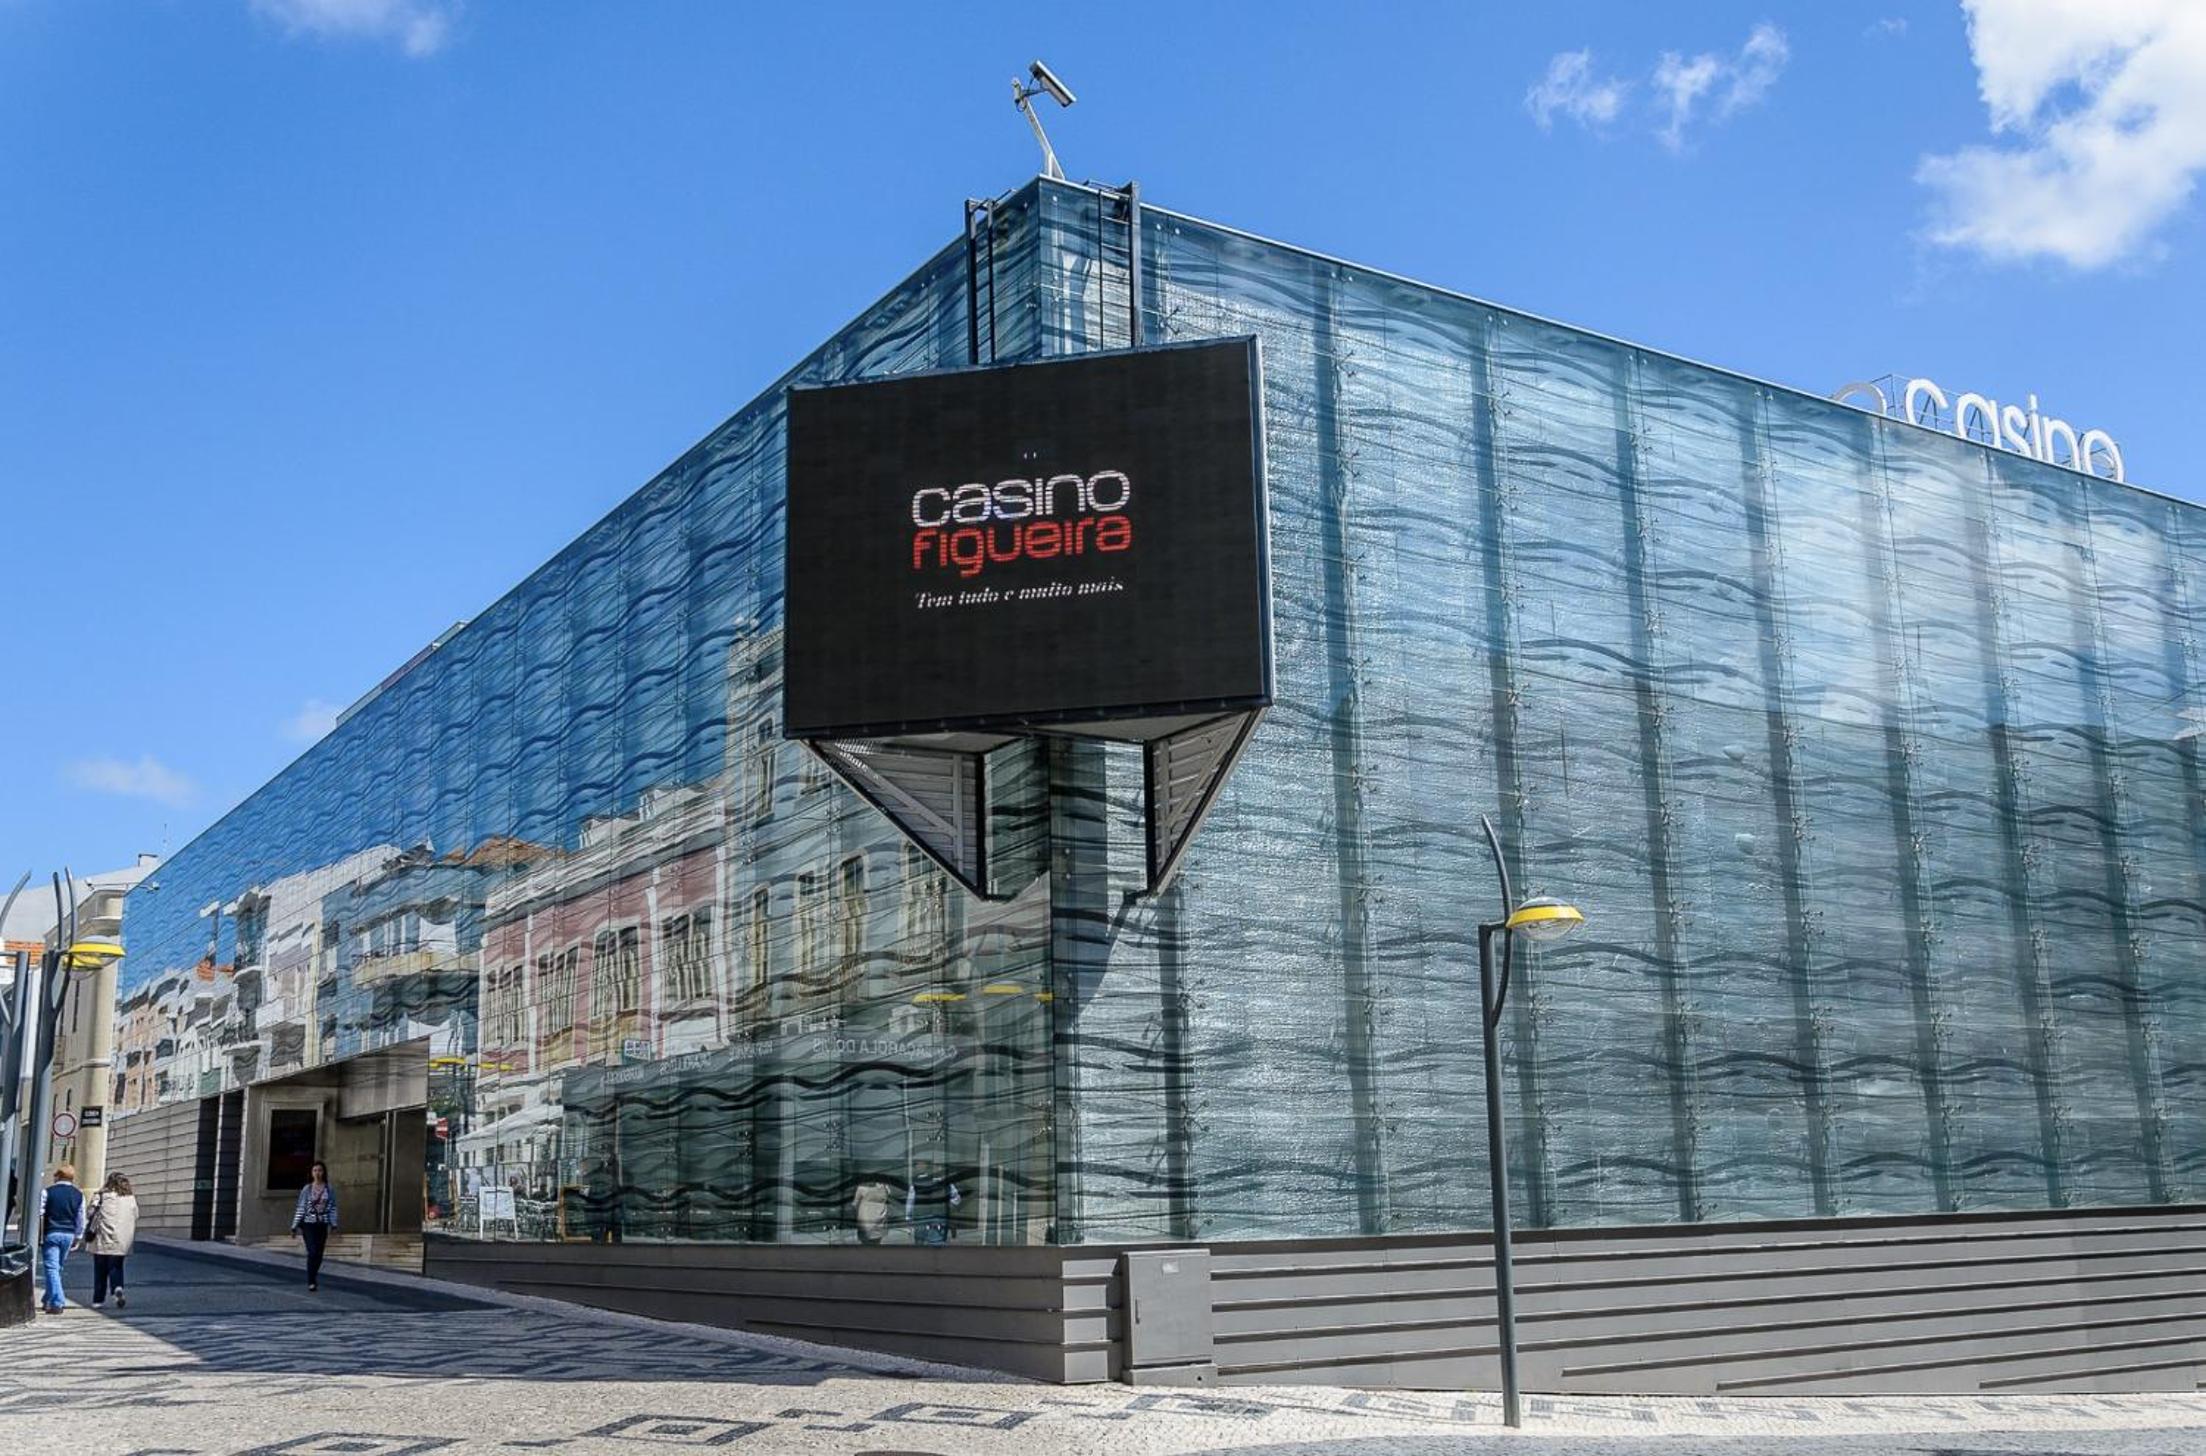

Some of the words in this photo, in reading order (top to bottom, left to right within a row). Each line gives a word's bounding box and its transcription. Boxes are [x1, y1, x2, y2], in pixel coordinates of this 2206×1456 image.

[912, 470, 1131, 528] casino
[912, 514, 1132, 577] figueira
[916, 591, 953, 609] Tem
[959, 586, 1000, 606] tudo
[1004, 588, 1015, 601] e
[1019, 581, 1073, 600] muito
[1078, 575, 1125, 595] mais
